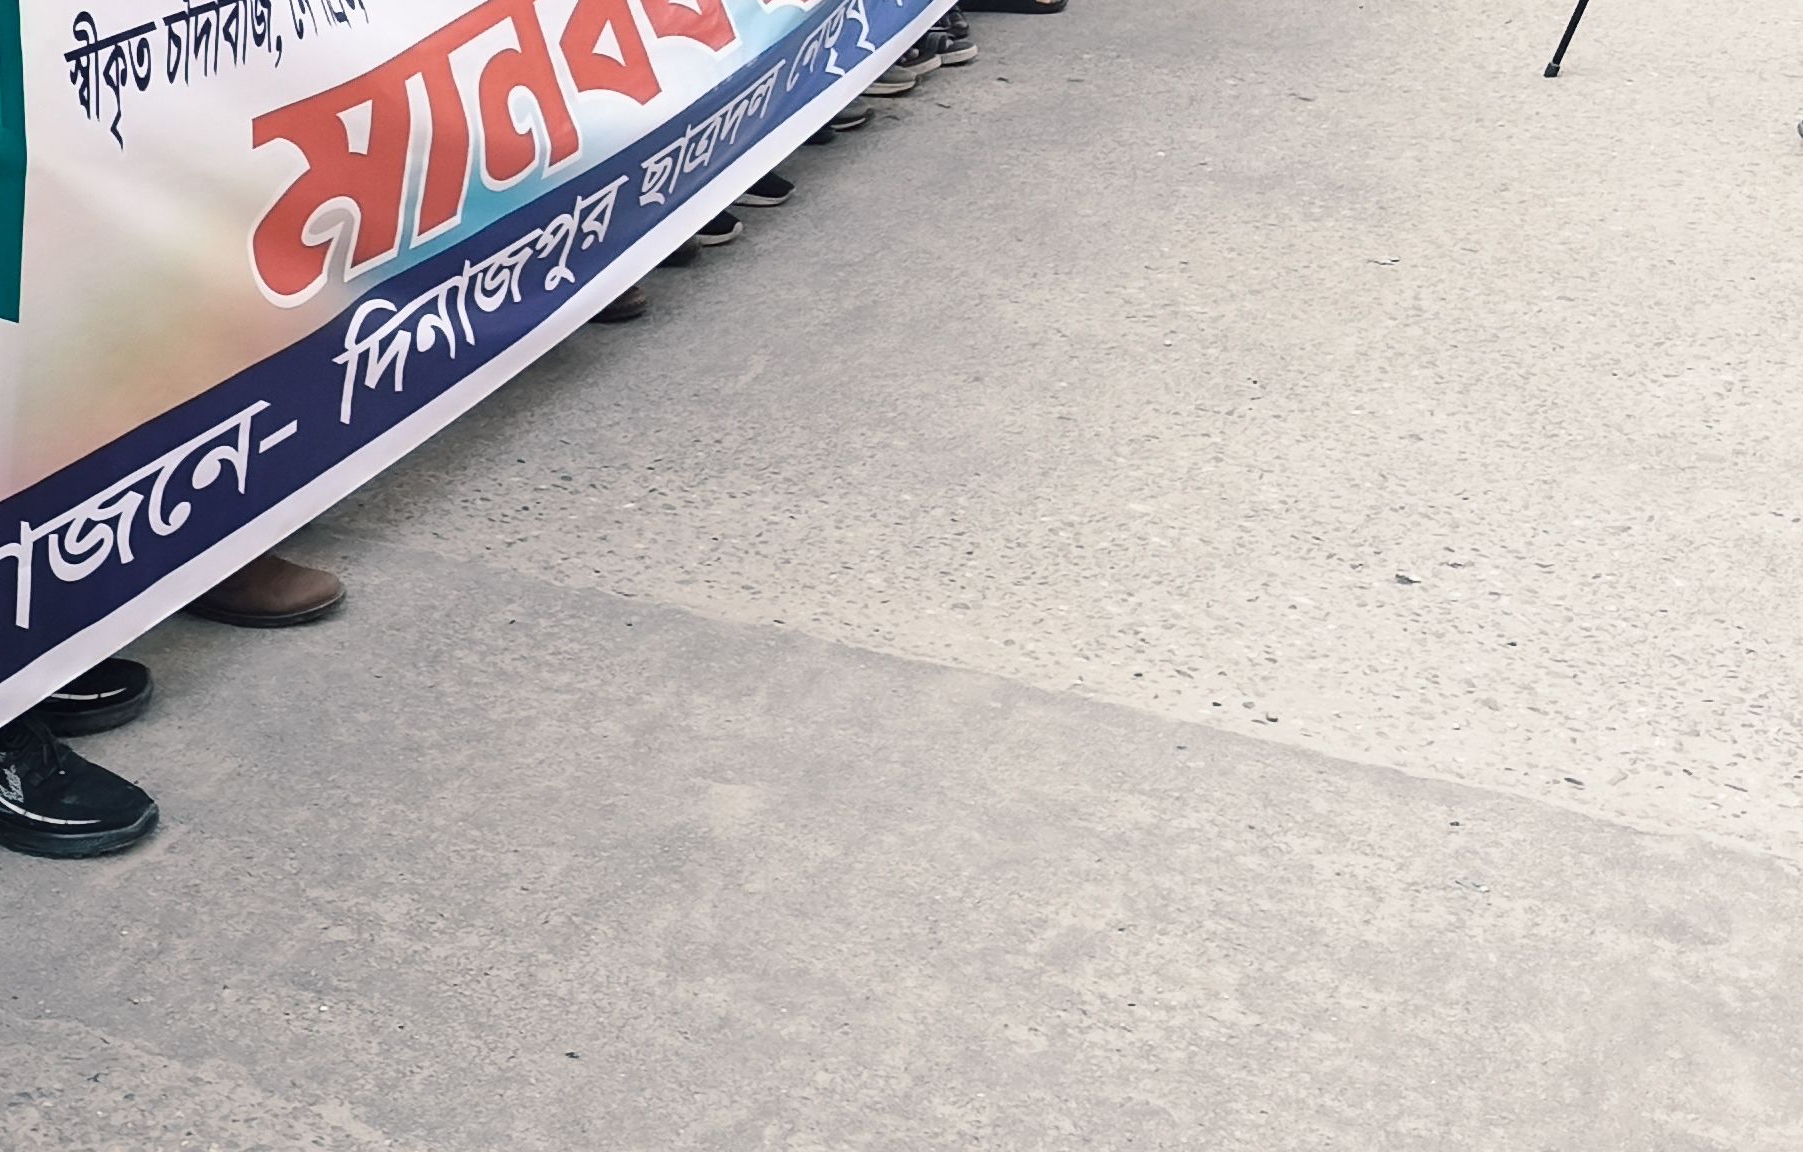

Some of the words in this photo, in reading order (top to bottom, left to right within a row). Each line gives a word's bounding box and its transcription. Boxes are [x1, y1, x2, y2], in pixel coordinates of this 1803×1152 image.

[64, 10, 158, 150] স্বীকৃত
[333, 174, 629, 425] দিনাজপুর
[638, 59, 787, 207] ছাত্রদল
